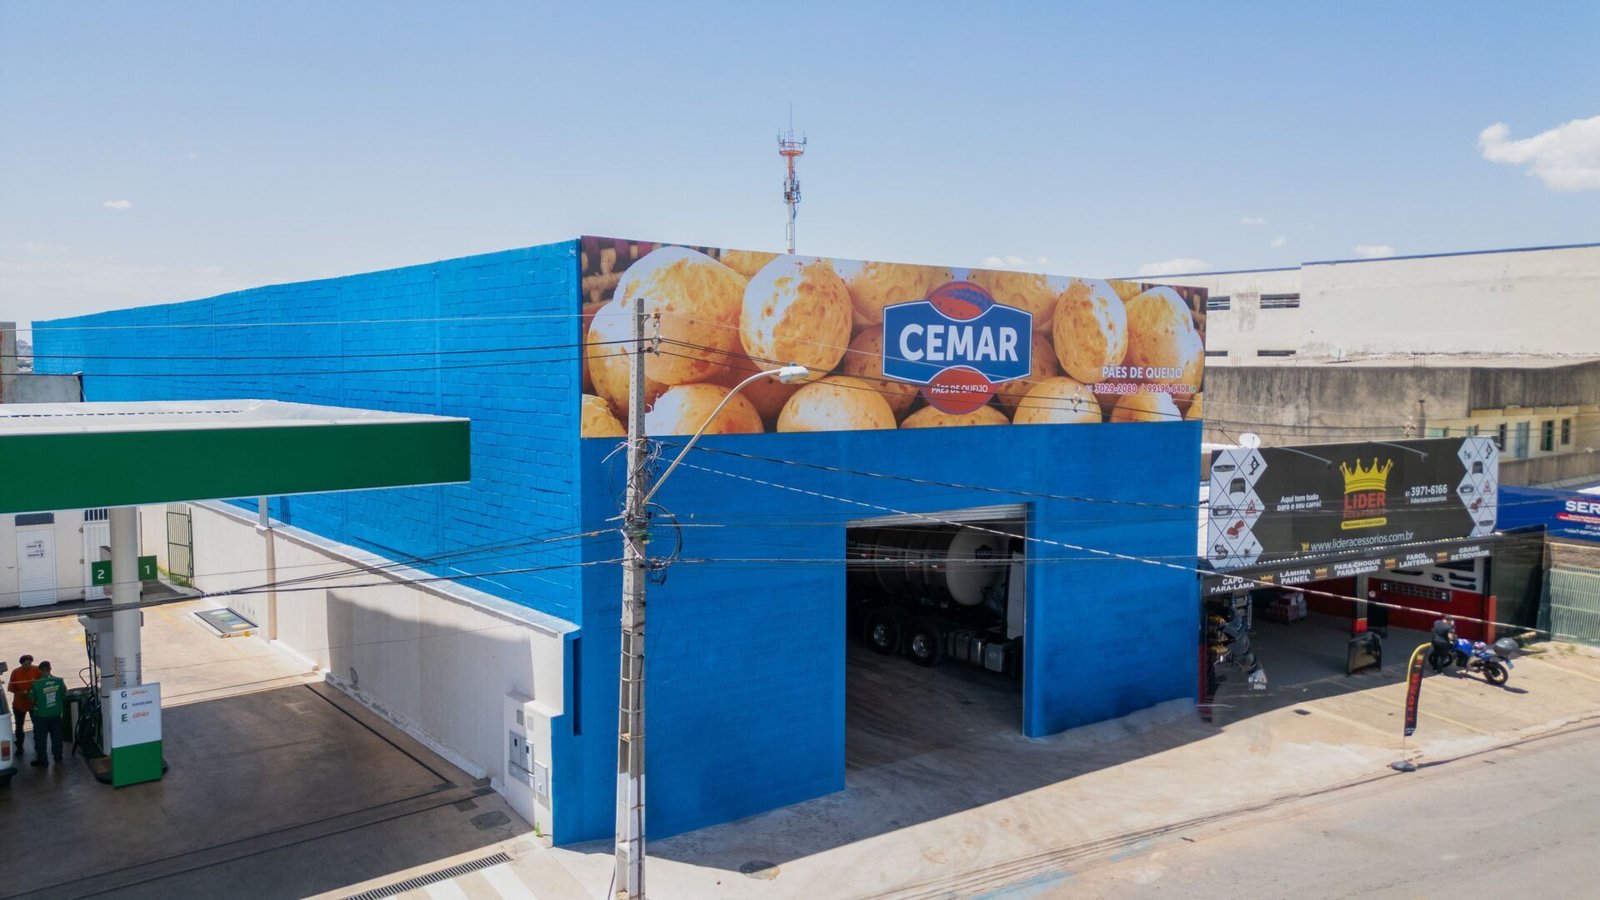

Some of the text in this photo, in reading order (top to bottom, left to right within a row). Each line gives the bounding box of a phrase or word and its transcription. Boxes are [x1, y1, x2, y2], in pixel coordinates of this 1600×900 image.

[899, 323, 1019, 361] CEMAR
[1130, 366, 1143, 378] DE
[1145, 367, 1183, 379] QUEIJO
[950, 384, 960, 394] DE
[1411, 484, 1448, 497] 3971-6166
[1280, 495, 1294, 504] Aqui
[1306, 493, 1319, 502] tudo
[1277, 503, 1290, 511] para
[1311, 531, 1414, 551] www.lideracessorios.com.br
[1399, 558, 1434, 568] LANTERNA
[97, 569, 105, 580] 2
[144, 565, 151, 575] 1
[1281, 575, 1309, 585] PAINEL
[120, 690, 128, 698] G
[121, 702, 128, 710] G
[121, 713, 128, 722] E
